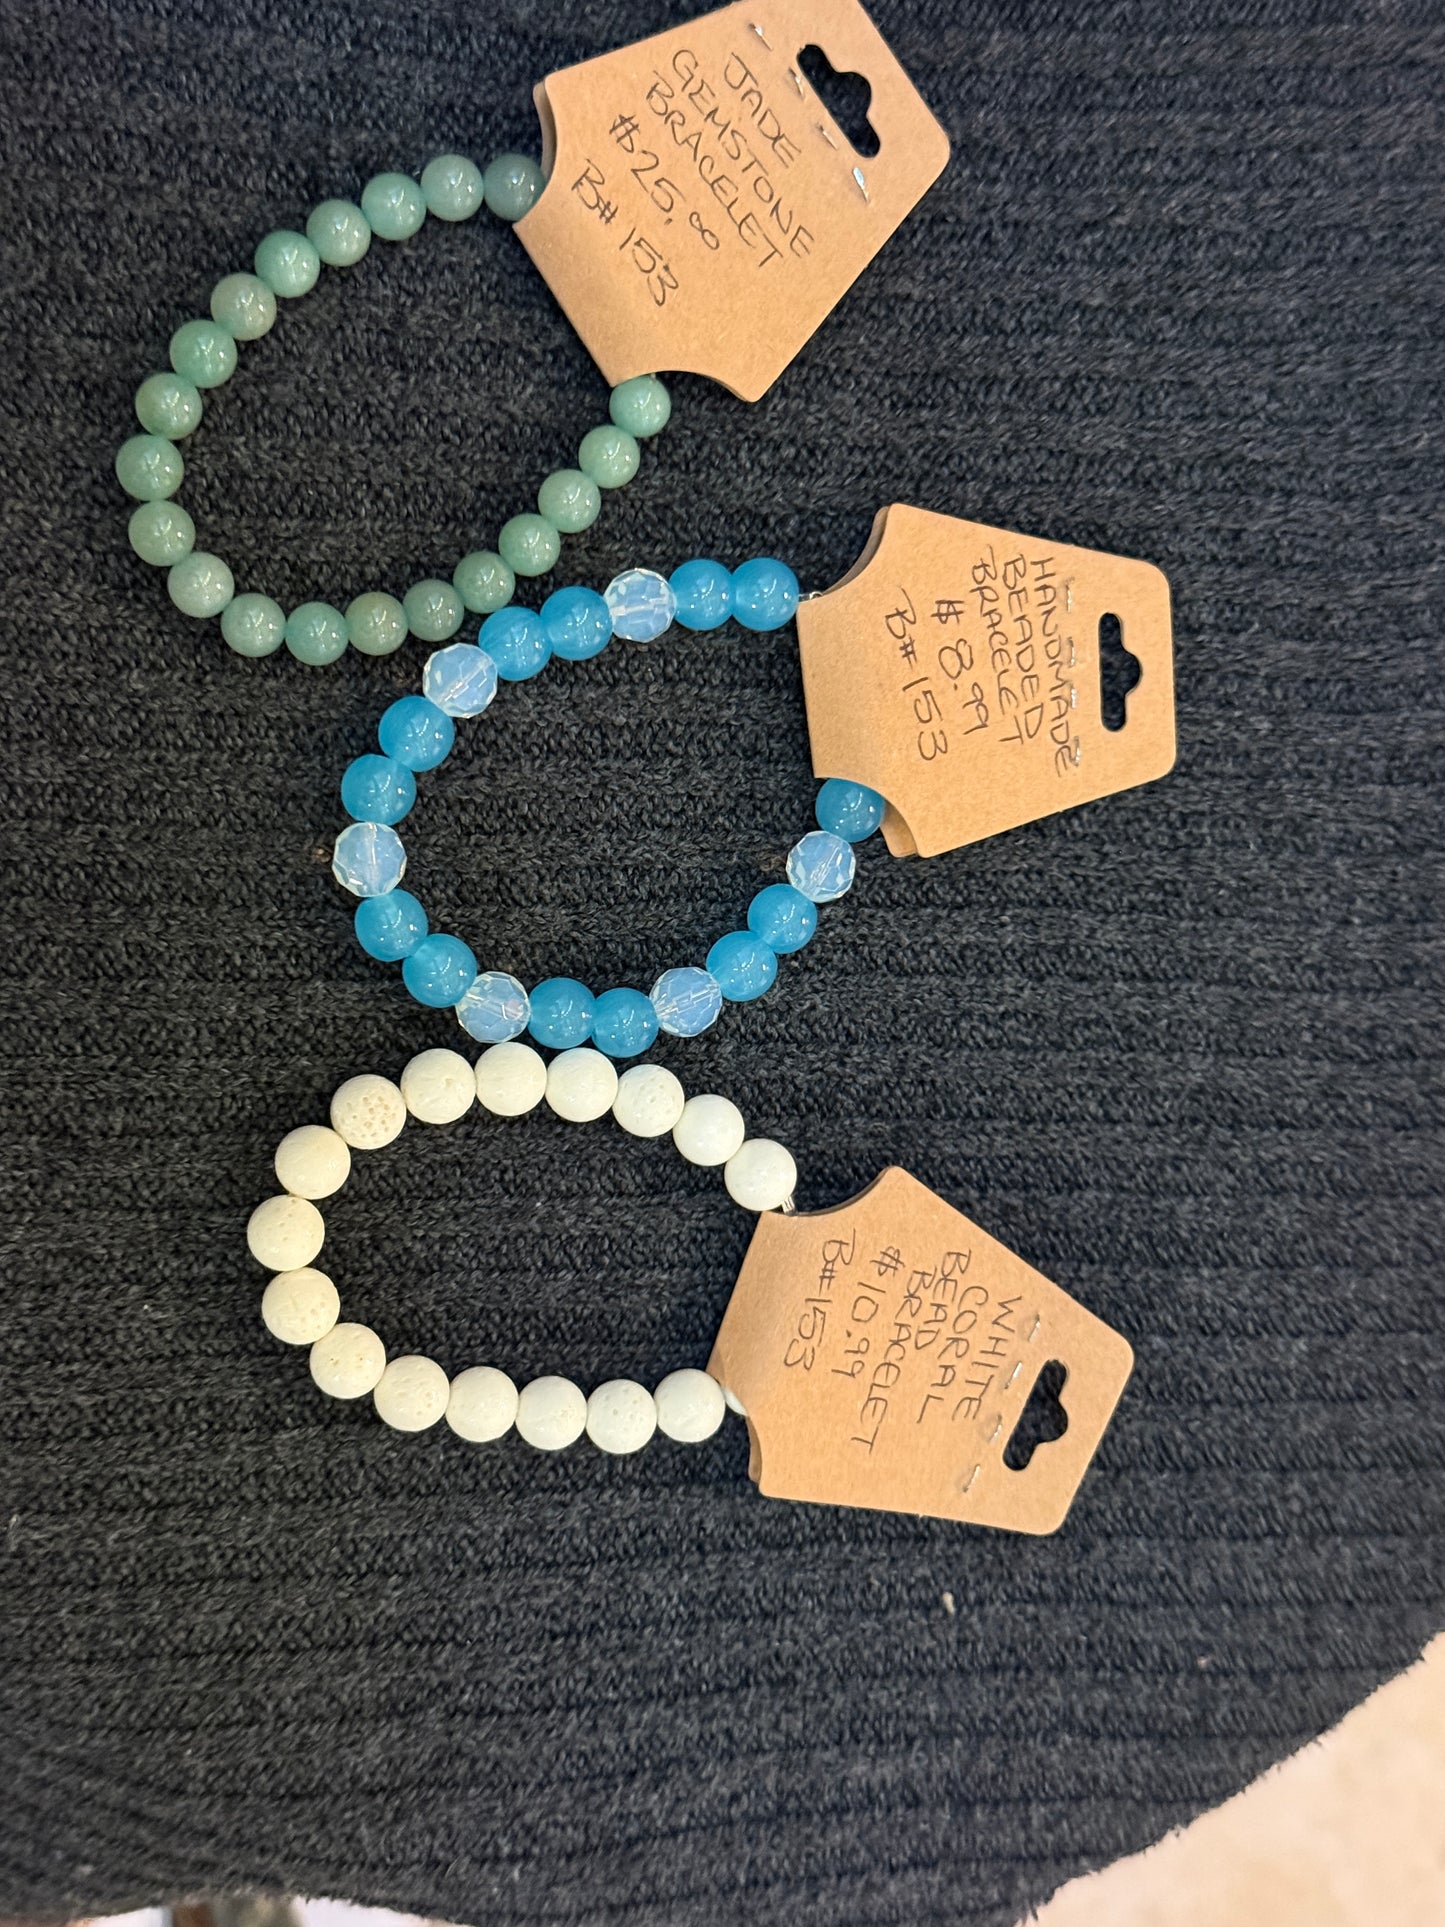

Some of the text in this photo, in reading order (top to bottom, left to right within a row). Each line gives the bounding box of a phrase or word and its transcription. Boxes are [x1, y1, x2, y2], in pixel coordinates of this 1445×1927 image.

[646, 69, 784, 267] BRACELET
[672, 49, 815, 258] GEMSTONE
[724, 52, 802, 169] JADE
[969, 546, 1024, 744] BRACELET
[1002, 553, 1044, 739] BEADED
[1030, 557, 1078, 777] HANDMADE
[850, 1265, 938, 1454] BRACELET
[914, 1249, 972, 1350] BEAD
[916, 1286, 989, 1424] CORAL
[952, 1296, 1022, 1420] WHITE
